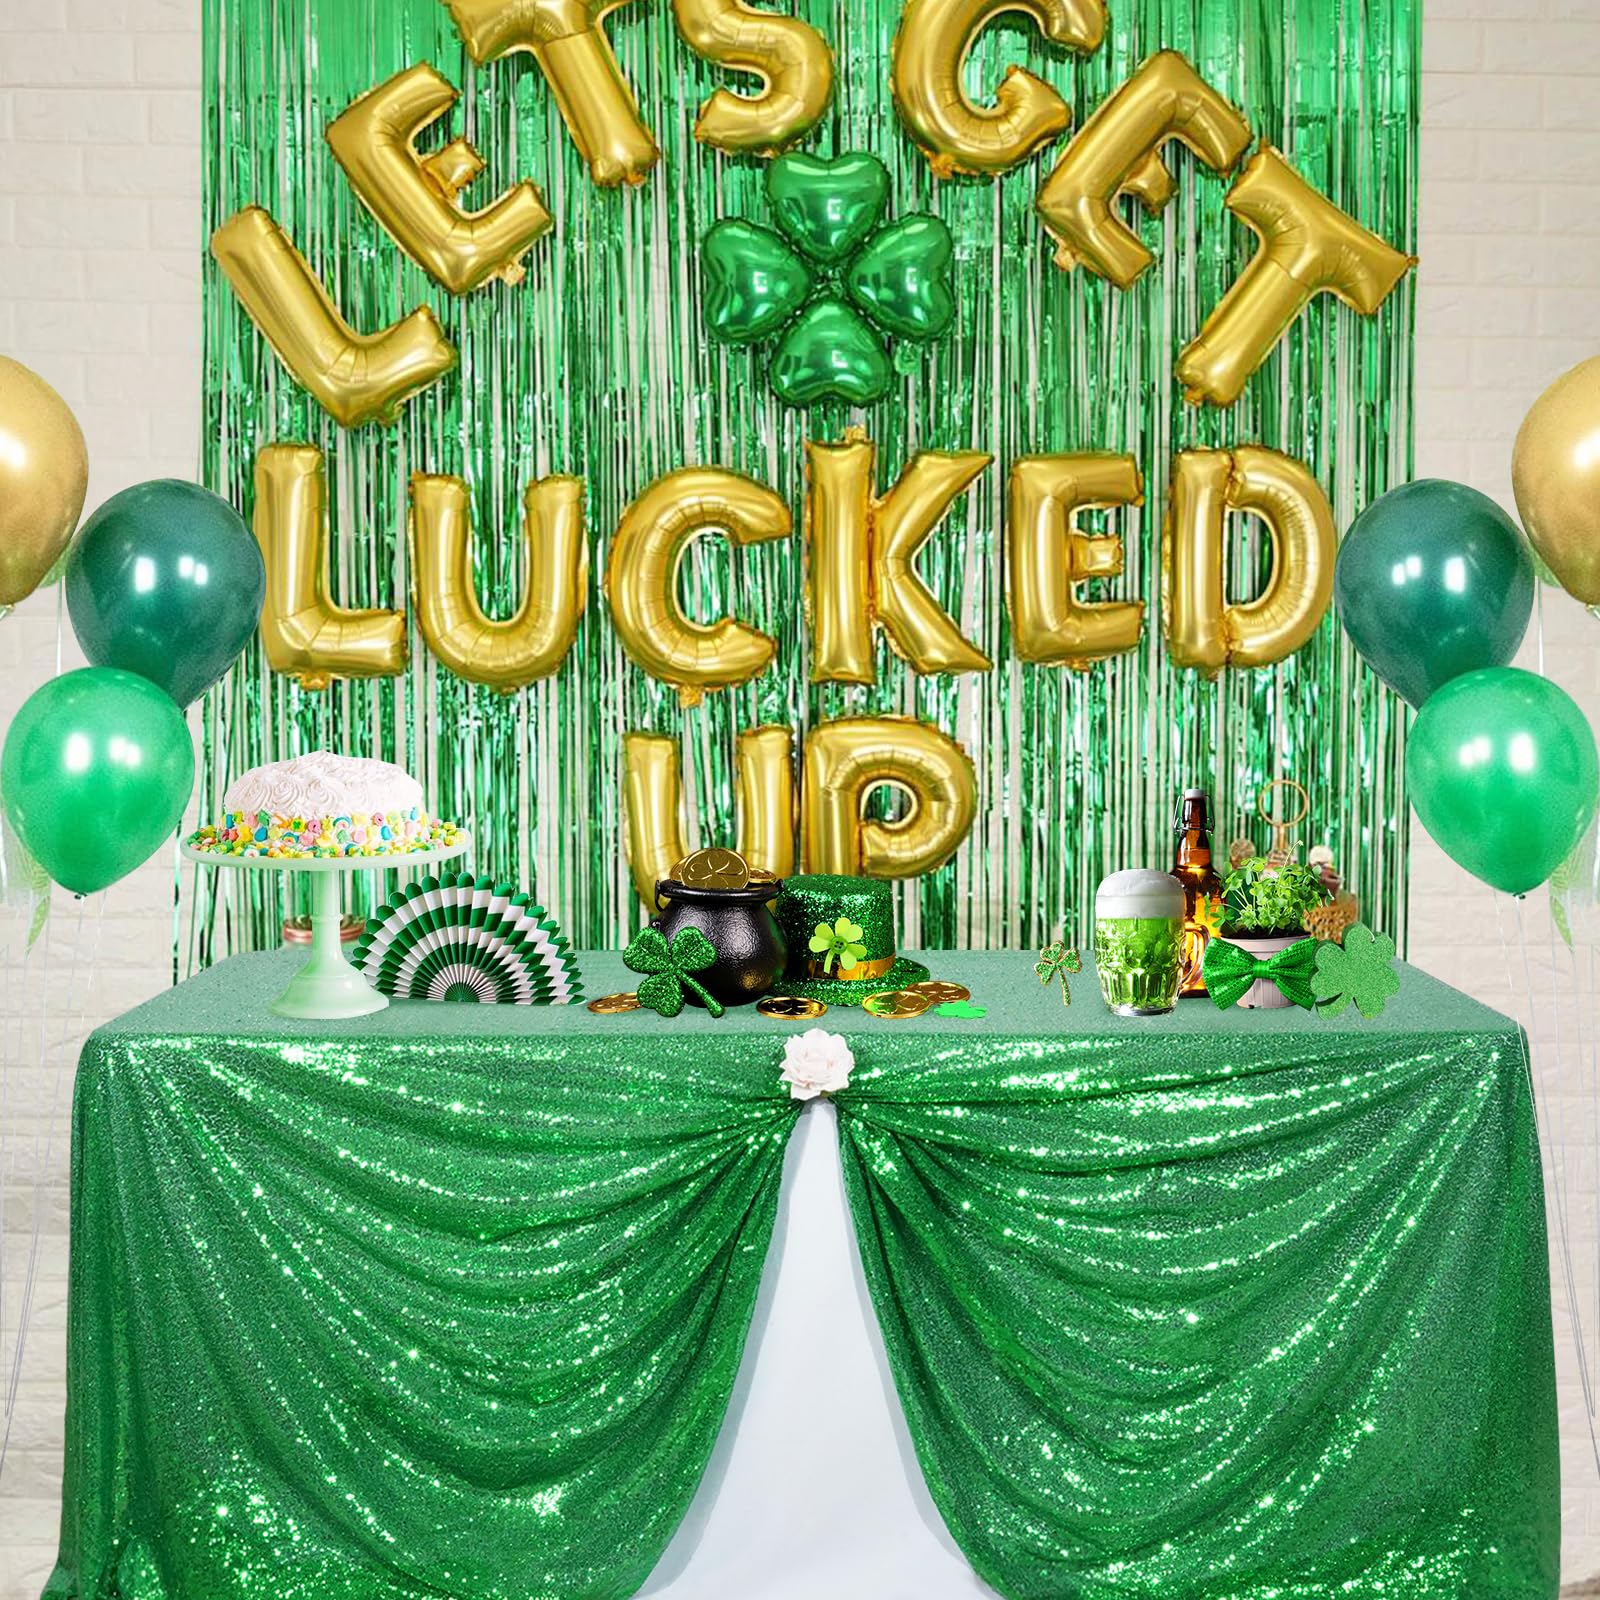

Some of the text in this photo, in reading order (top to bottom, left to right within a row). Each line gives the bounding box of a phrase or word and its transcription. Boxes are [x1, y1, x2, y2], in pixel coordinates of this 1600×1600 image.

[211, 0, 1418, 426] LETS GET
[254, 430, 1337, 704] LUCKED
[622, 714, 978, 914] UP
